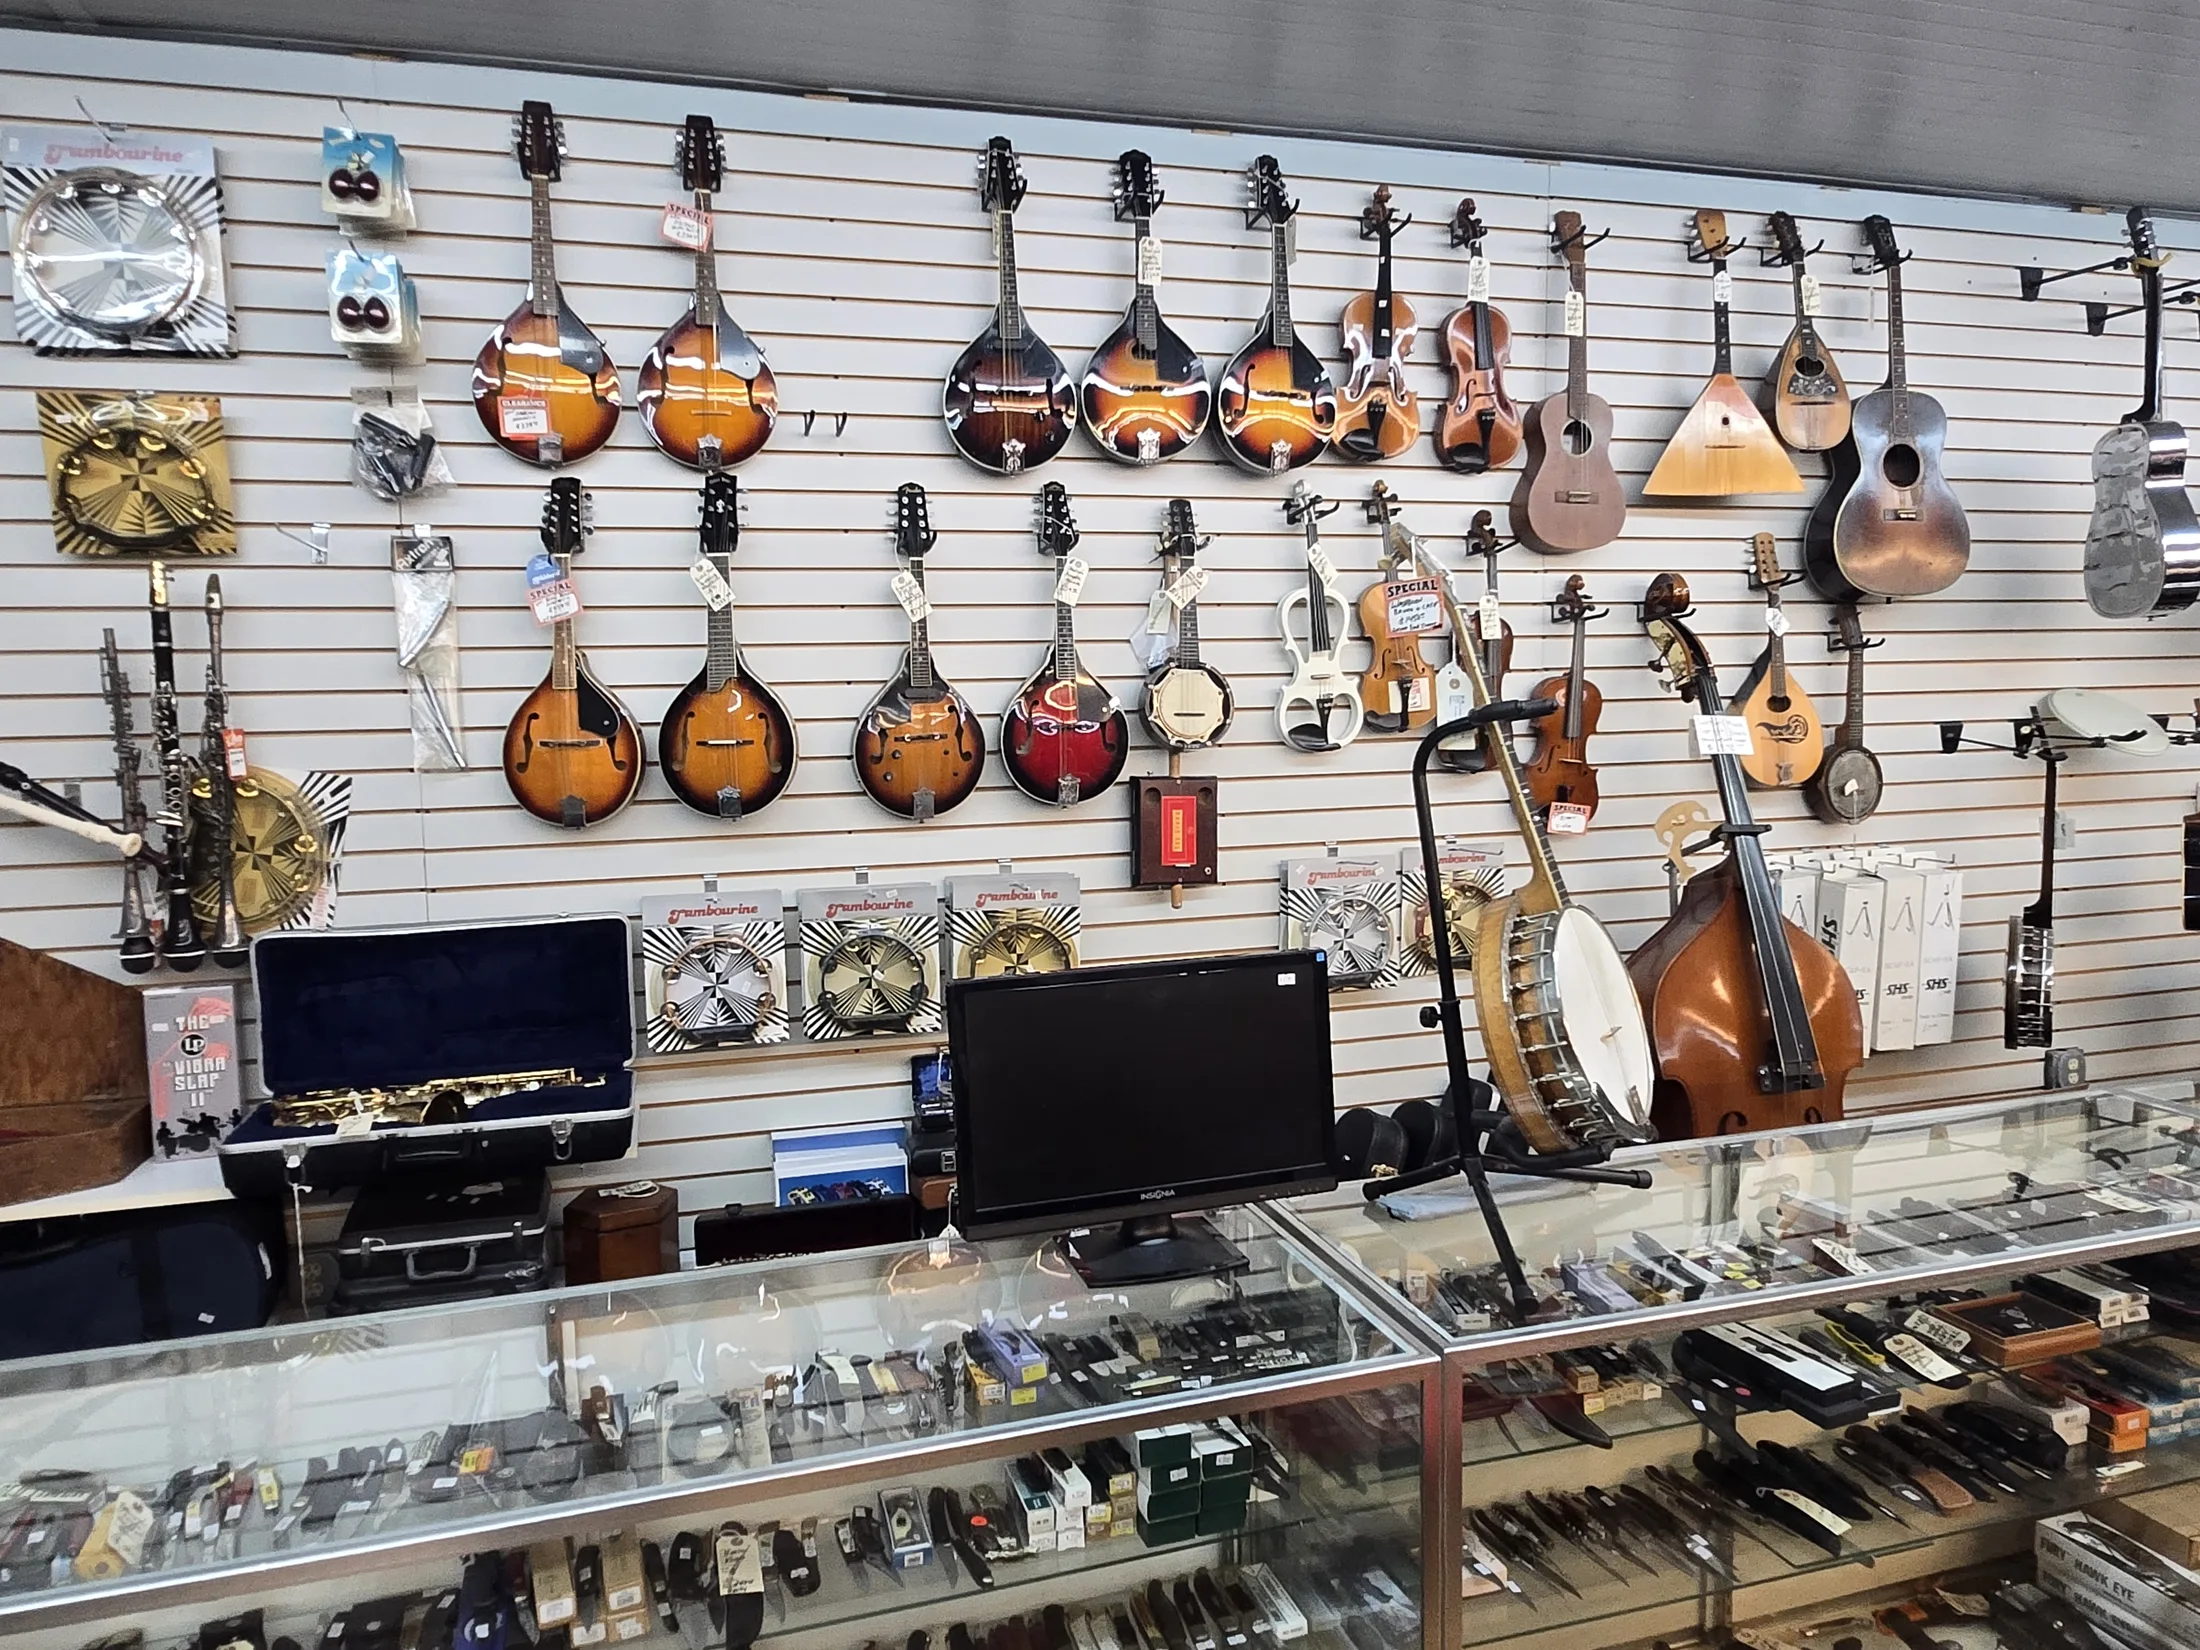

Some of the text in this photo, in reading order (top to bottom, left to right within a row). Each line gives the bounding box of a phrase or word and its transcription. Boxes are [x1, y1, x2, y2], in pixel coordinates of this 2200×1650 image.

[44, 143, 183, 165] Tambourine
[669, 203, 709, 225] SPECIAL
[530, 582, 572, 600] SPECIAL
[1387, 579, 1438, 598] SPECIAL
[1554, 804, 1587, 814] SPECIAL
[975, 889, 1058, 907] Tambouine
[668, 903, 758, 925] Tambourine
[826, 898, 914, 918] Tambourine
[1886, 982, 1910, 996] SHS
[1925, 978, 1949, 990] SHS
[175, 1014, 210, 1032] THE
[185, 1037, 205, 1052] LP
[174, 1057, 226, 1075] VIBRA
[175, 1073, 220, 1091] SLAP
[191, 1092, 205, 1107] II
[1140, 1189, 1175, 1200] INSIGNIA
[2074, 1558, 2109, 1589] HAWK
[2113, 1581, 2135, 1603] EYE
